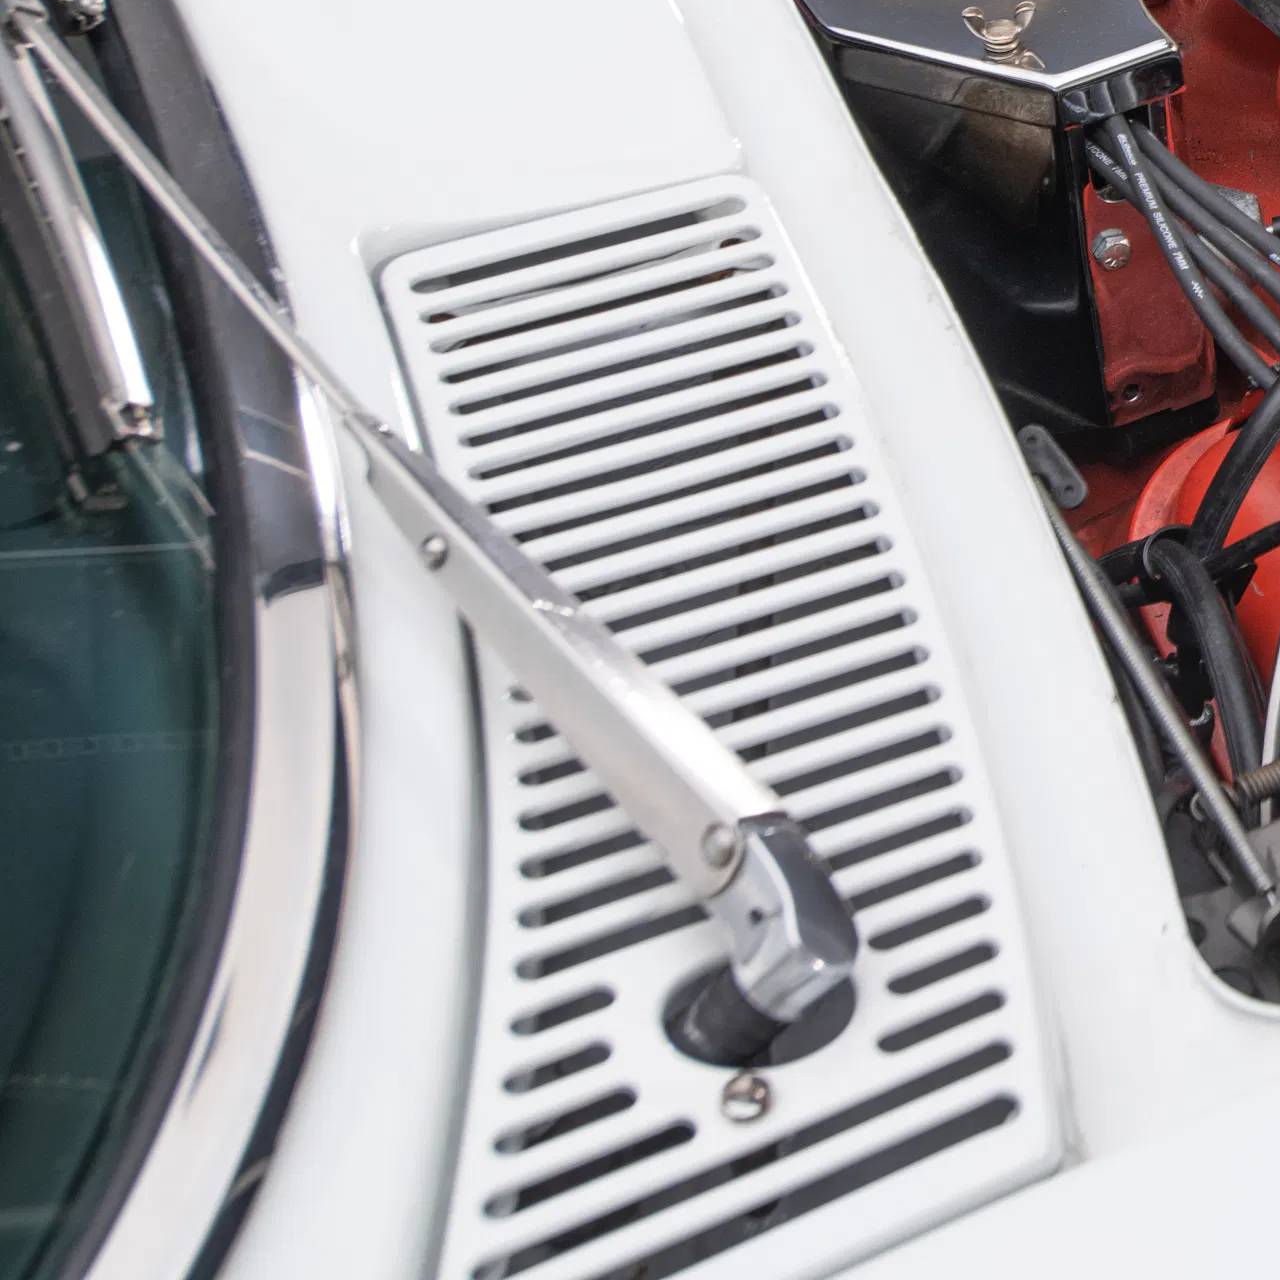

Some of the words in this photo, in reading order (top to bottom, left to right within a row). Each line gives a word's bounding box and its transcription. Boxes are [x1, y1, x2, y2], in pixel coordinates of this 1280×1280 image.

[1134, 172, 1158, 210] PREMIUM
[1152, 212, 1178, 250] SILICONE
[1172, 252, 1190, 270] 7MM
